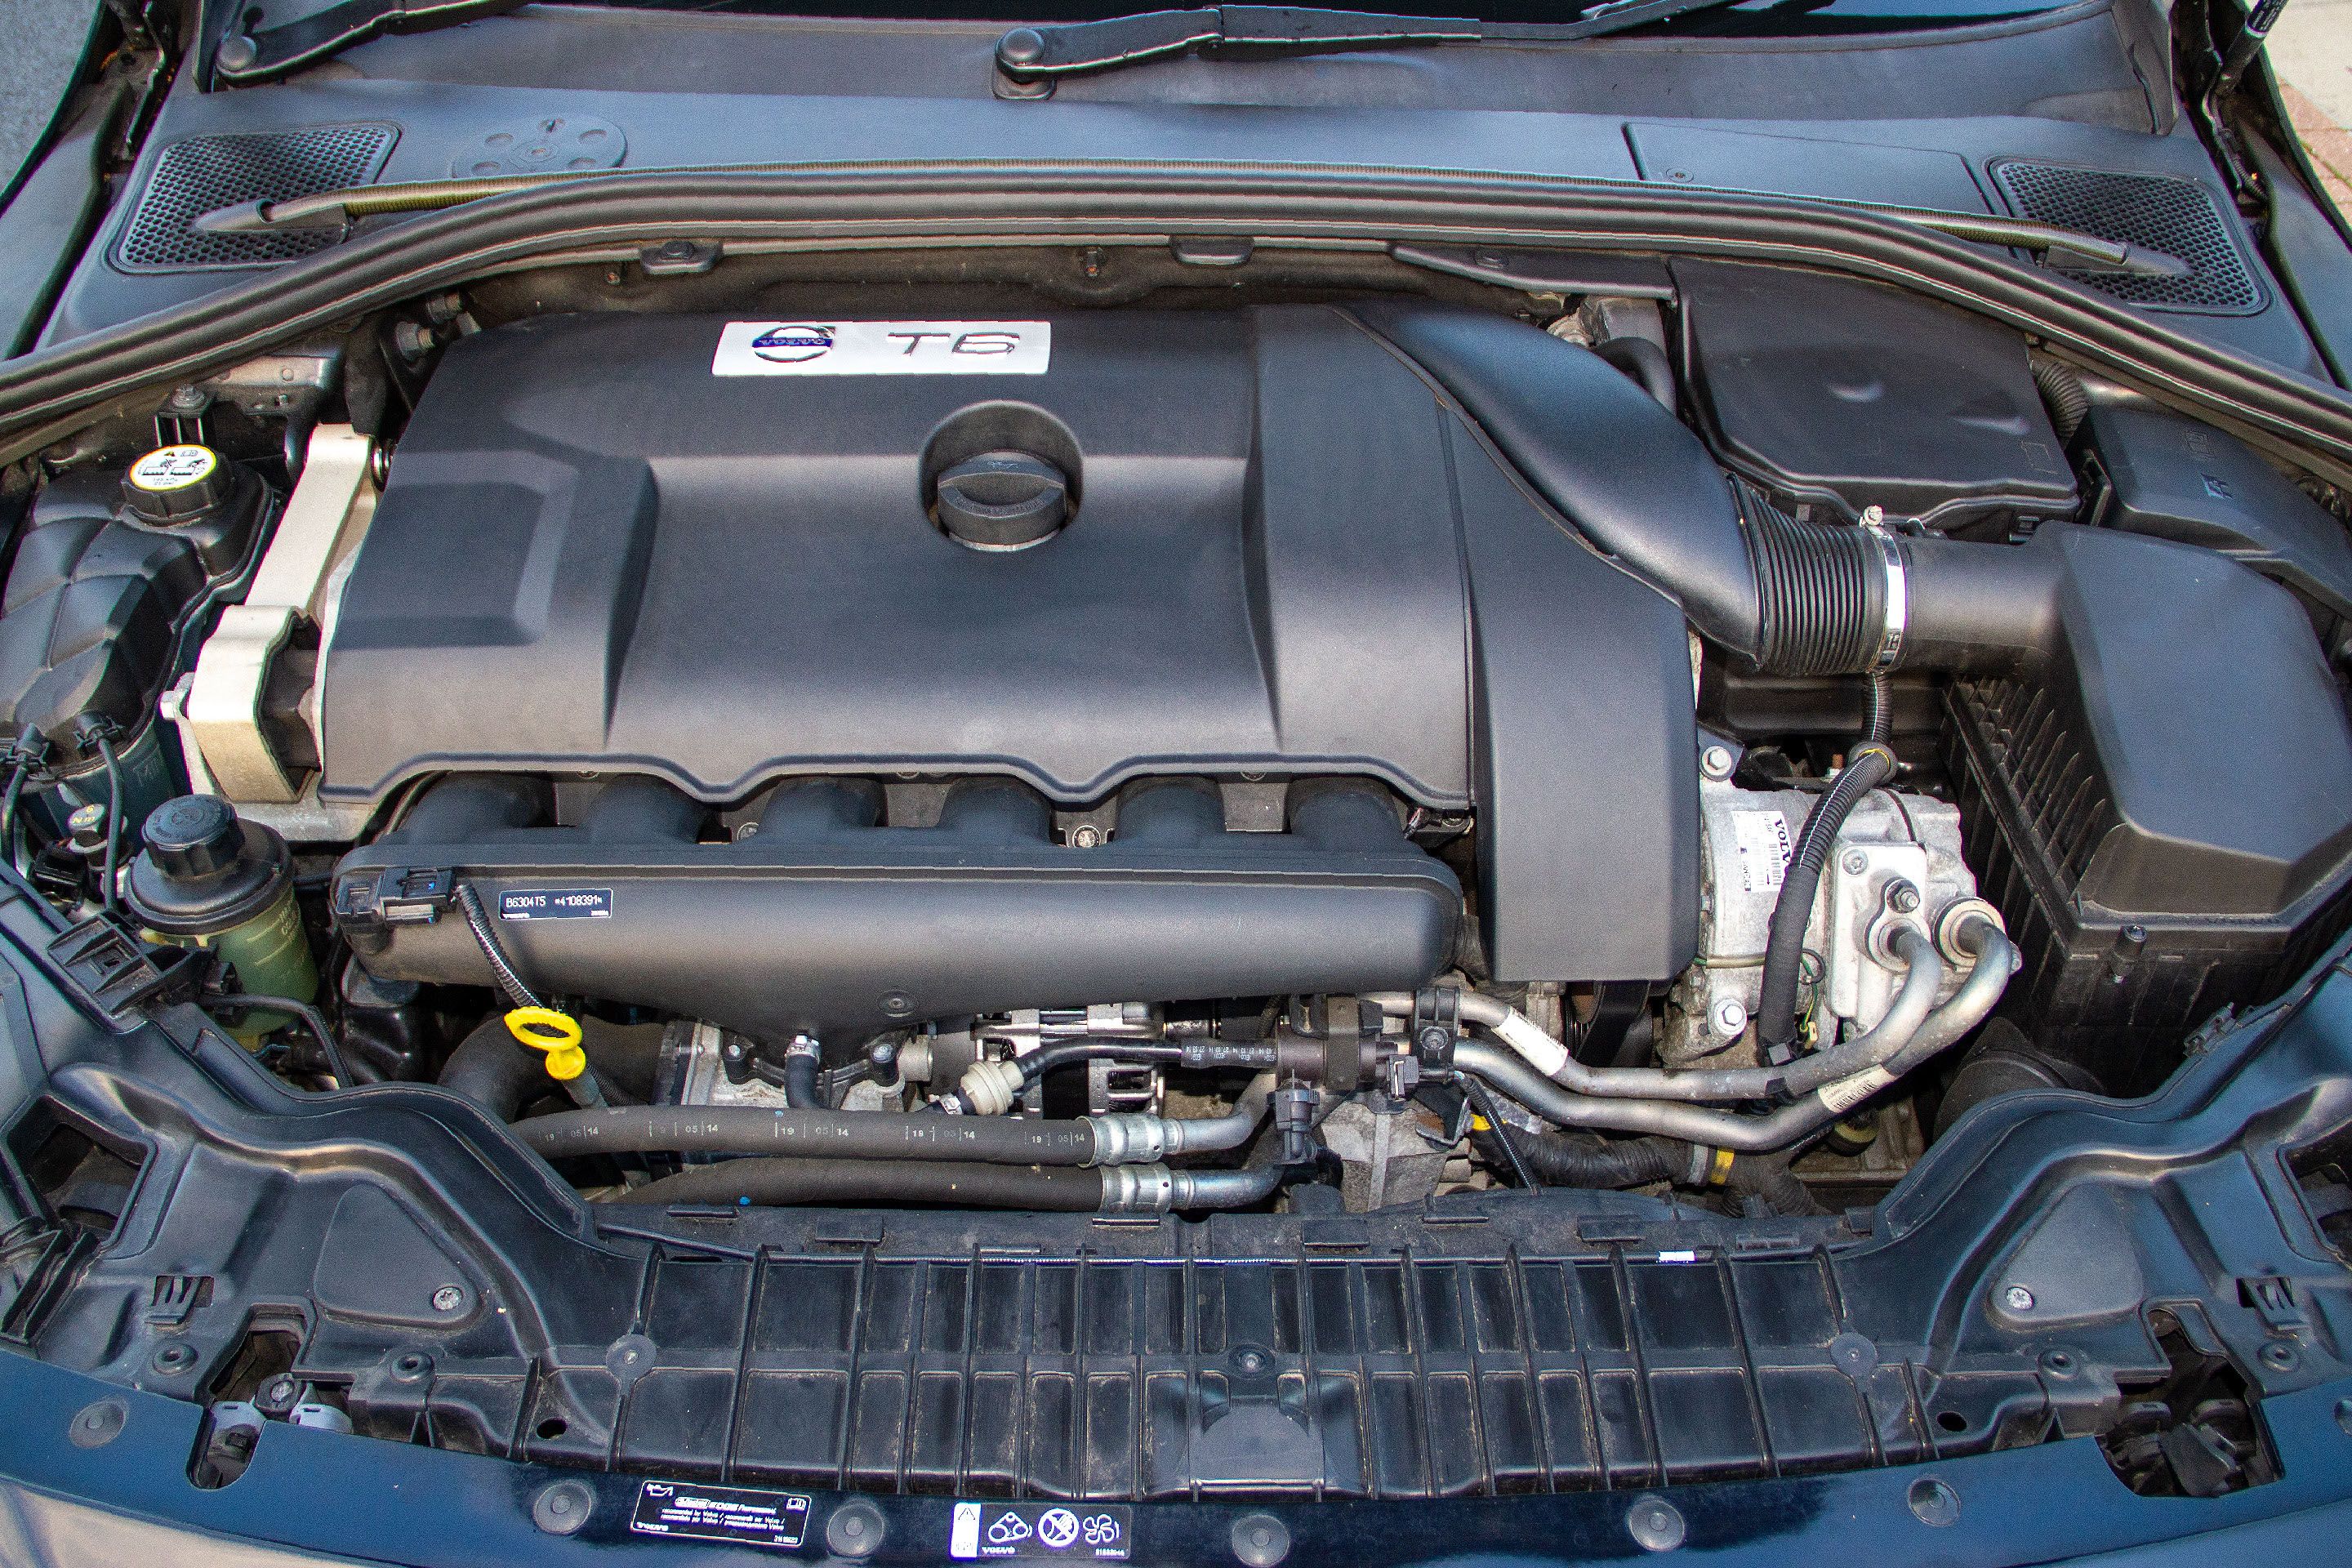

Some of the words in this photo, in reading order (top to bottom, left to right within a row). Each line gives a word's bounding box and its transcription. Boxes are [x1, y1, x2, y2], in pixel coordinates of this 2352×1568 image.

[758, 336, 826, 346] VOLVO
[887, 331, 1020, 356] T6
[1775, 818, 1791, 862] VOLV
[506, 896, 546, 908] B6304T5
[587, 1126, 599, 1135] 14
[685, 1125, 697, 1134] 05
[706, 1124, 718, 1133] 14
[781, 1127, 795, 1136] 19
[837, 1127, 849, 1137] 14
[964, 1130, 975, 1139] 14
[1031, 1134, 1042, 1143] 19
[1074, 1134, 1085, 1143] 14
